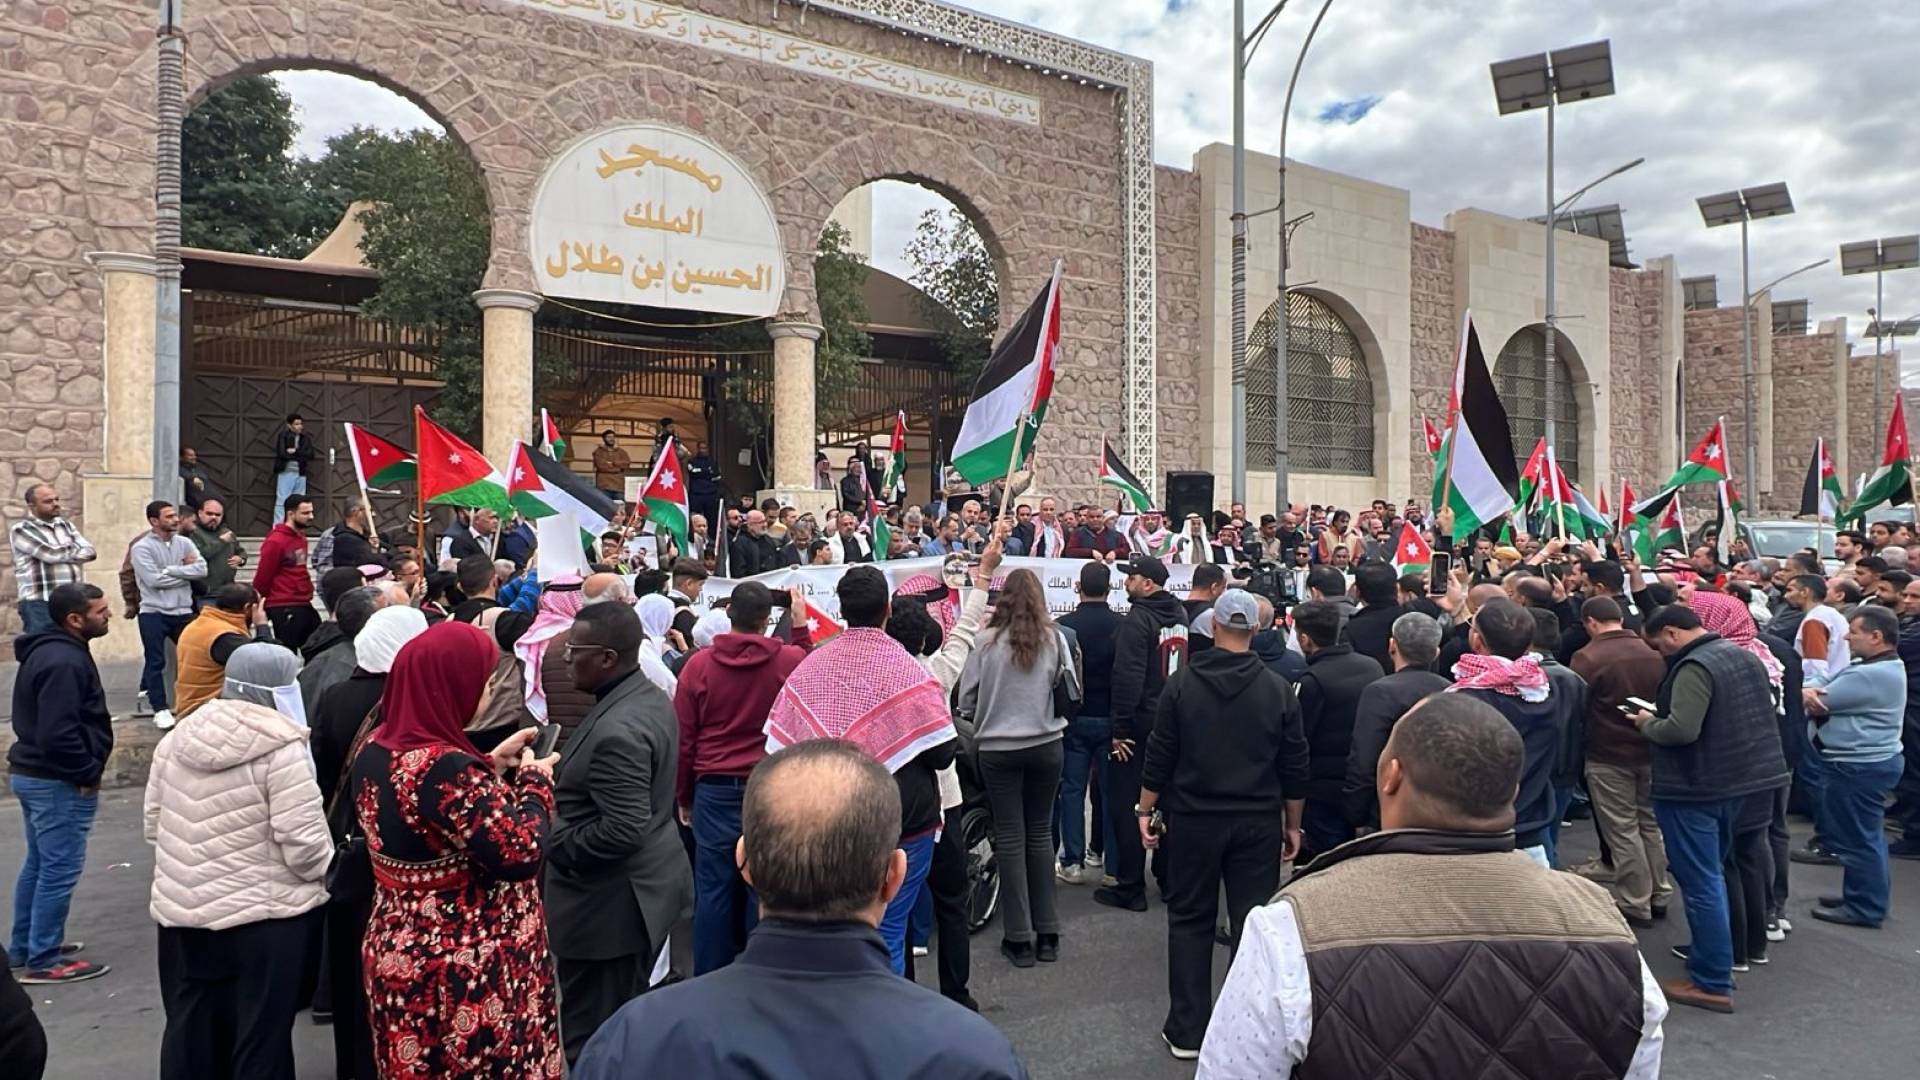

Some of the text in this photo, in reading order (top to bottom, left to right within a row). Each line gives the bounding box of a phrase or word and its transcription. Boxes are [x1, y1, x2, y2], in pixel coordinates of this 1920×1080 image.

[595, 143, 722, 193] مسجد
[623, 201, 704, 237] الملك
[546, 239, 773, 294] الحسين بن طلال
